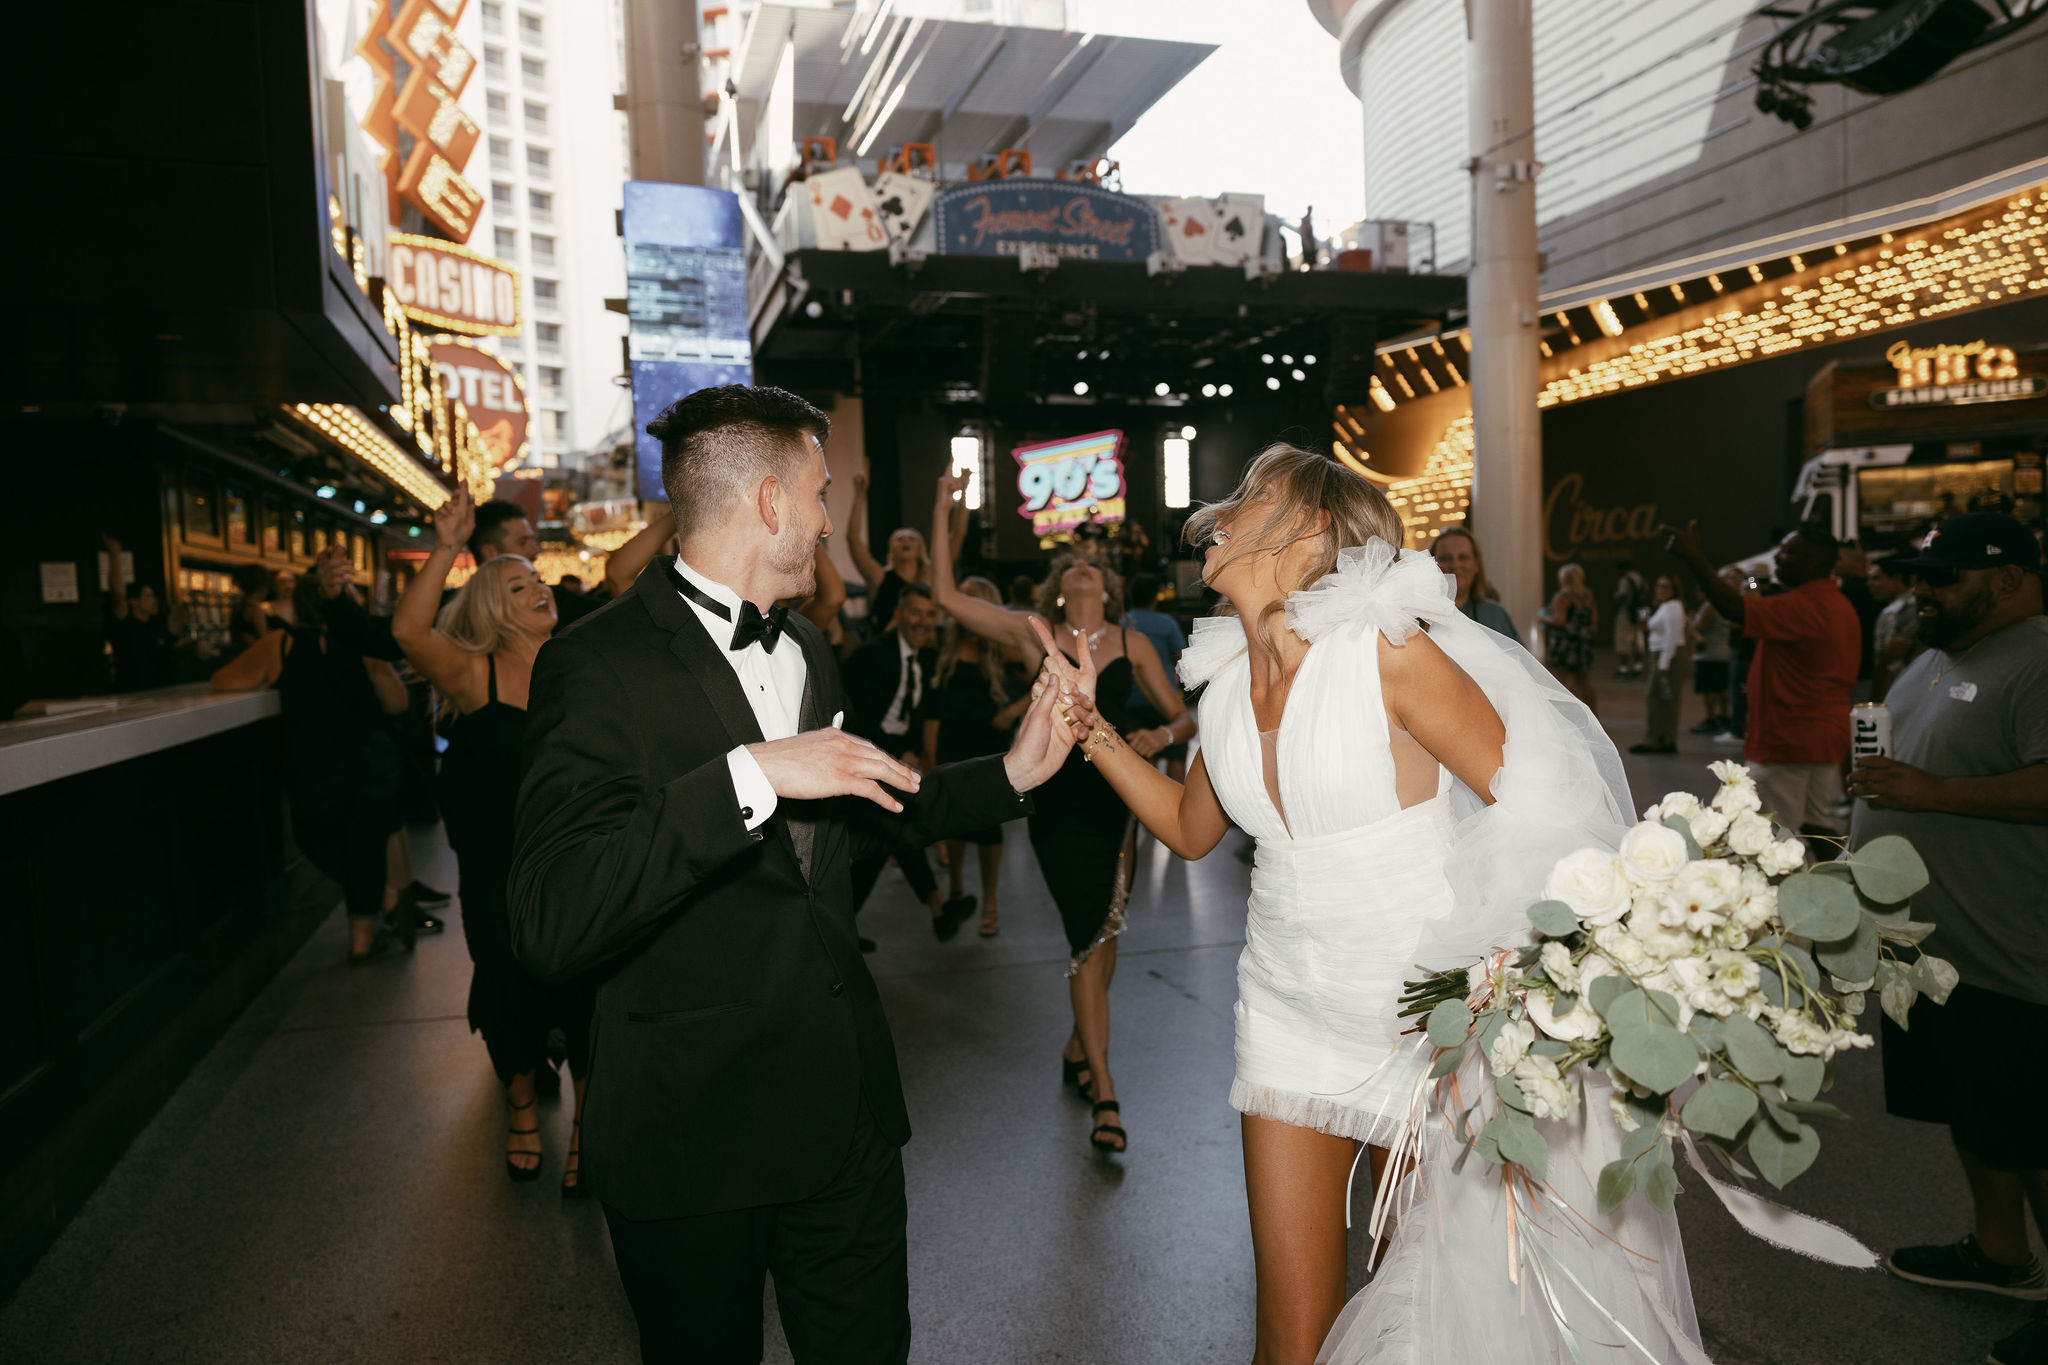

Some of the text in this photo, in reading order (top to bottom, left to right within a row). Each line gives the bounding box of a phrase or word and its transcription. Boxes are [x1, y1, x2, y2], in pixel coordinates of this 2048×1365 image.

[996, 240, 1099, 260] EXPENCE
[391, 246, 517, 326] CASINO
[436, 362, 523, 414] OTEL
[1886, 378, 2034, 406] SANDWICHES
[1543, 472, 1661, 562] Circa
[1855, 719, 1882, 757] ite
